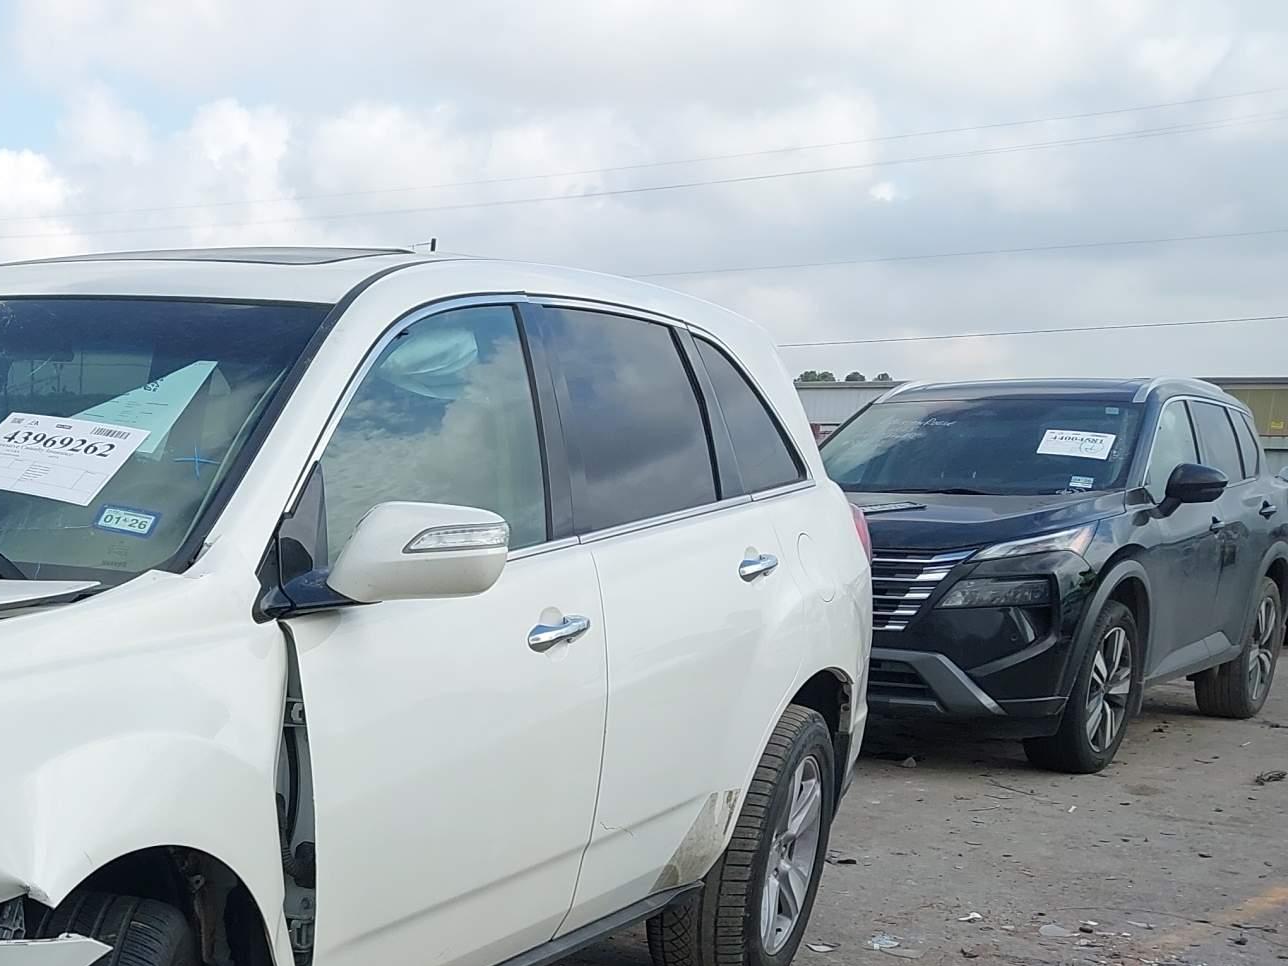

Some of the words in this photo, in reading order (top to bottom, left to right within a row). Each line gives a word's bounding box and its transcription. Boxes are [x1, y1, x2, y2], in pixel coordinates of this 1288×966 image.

[3, 429, 115, 458] 43969262
[103, 514, 121, 525] 01
[128, 518, 148, 530] 26
